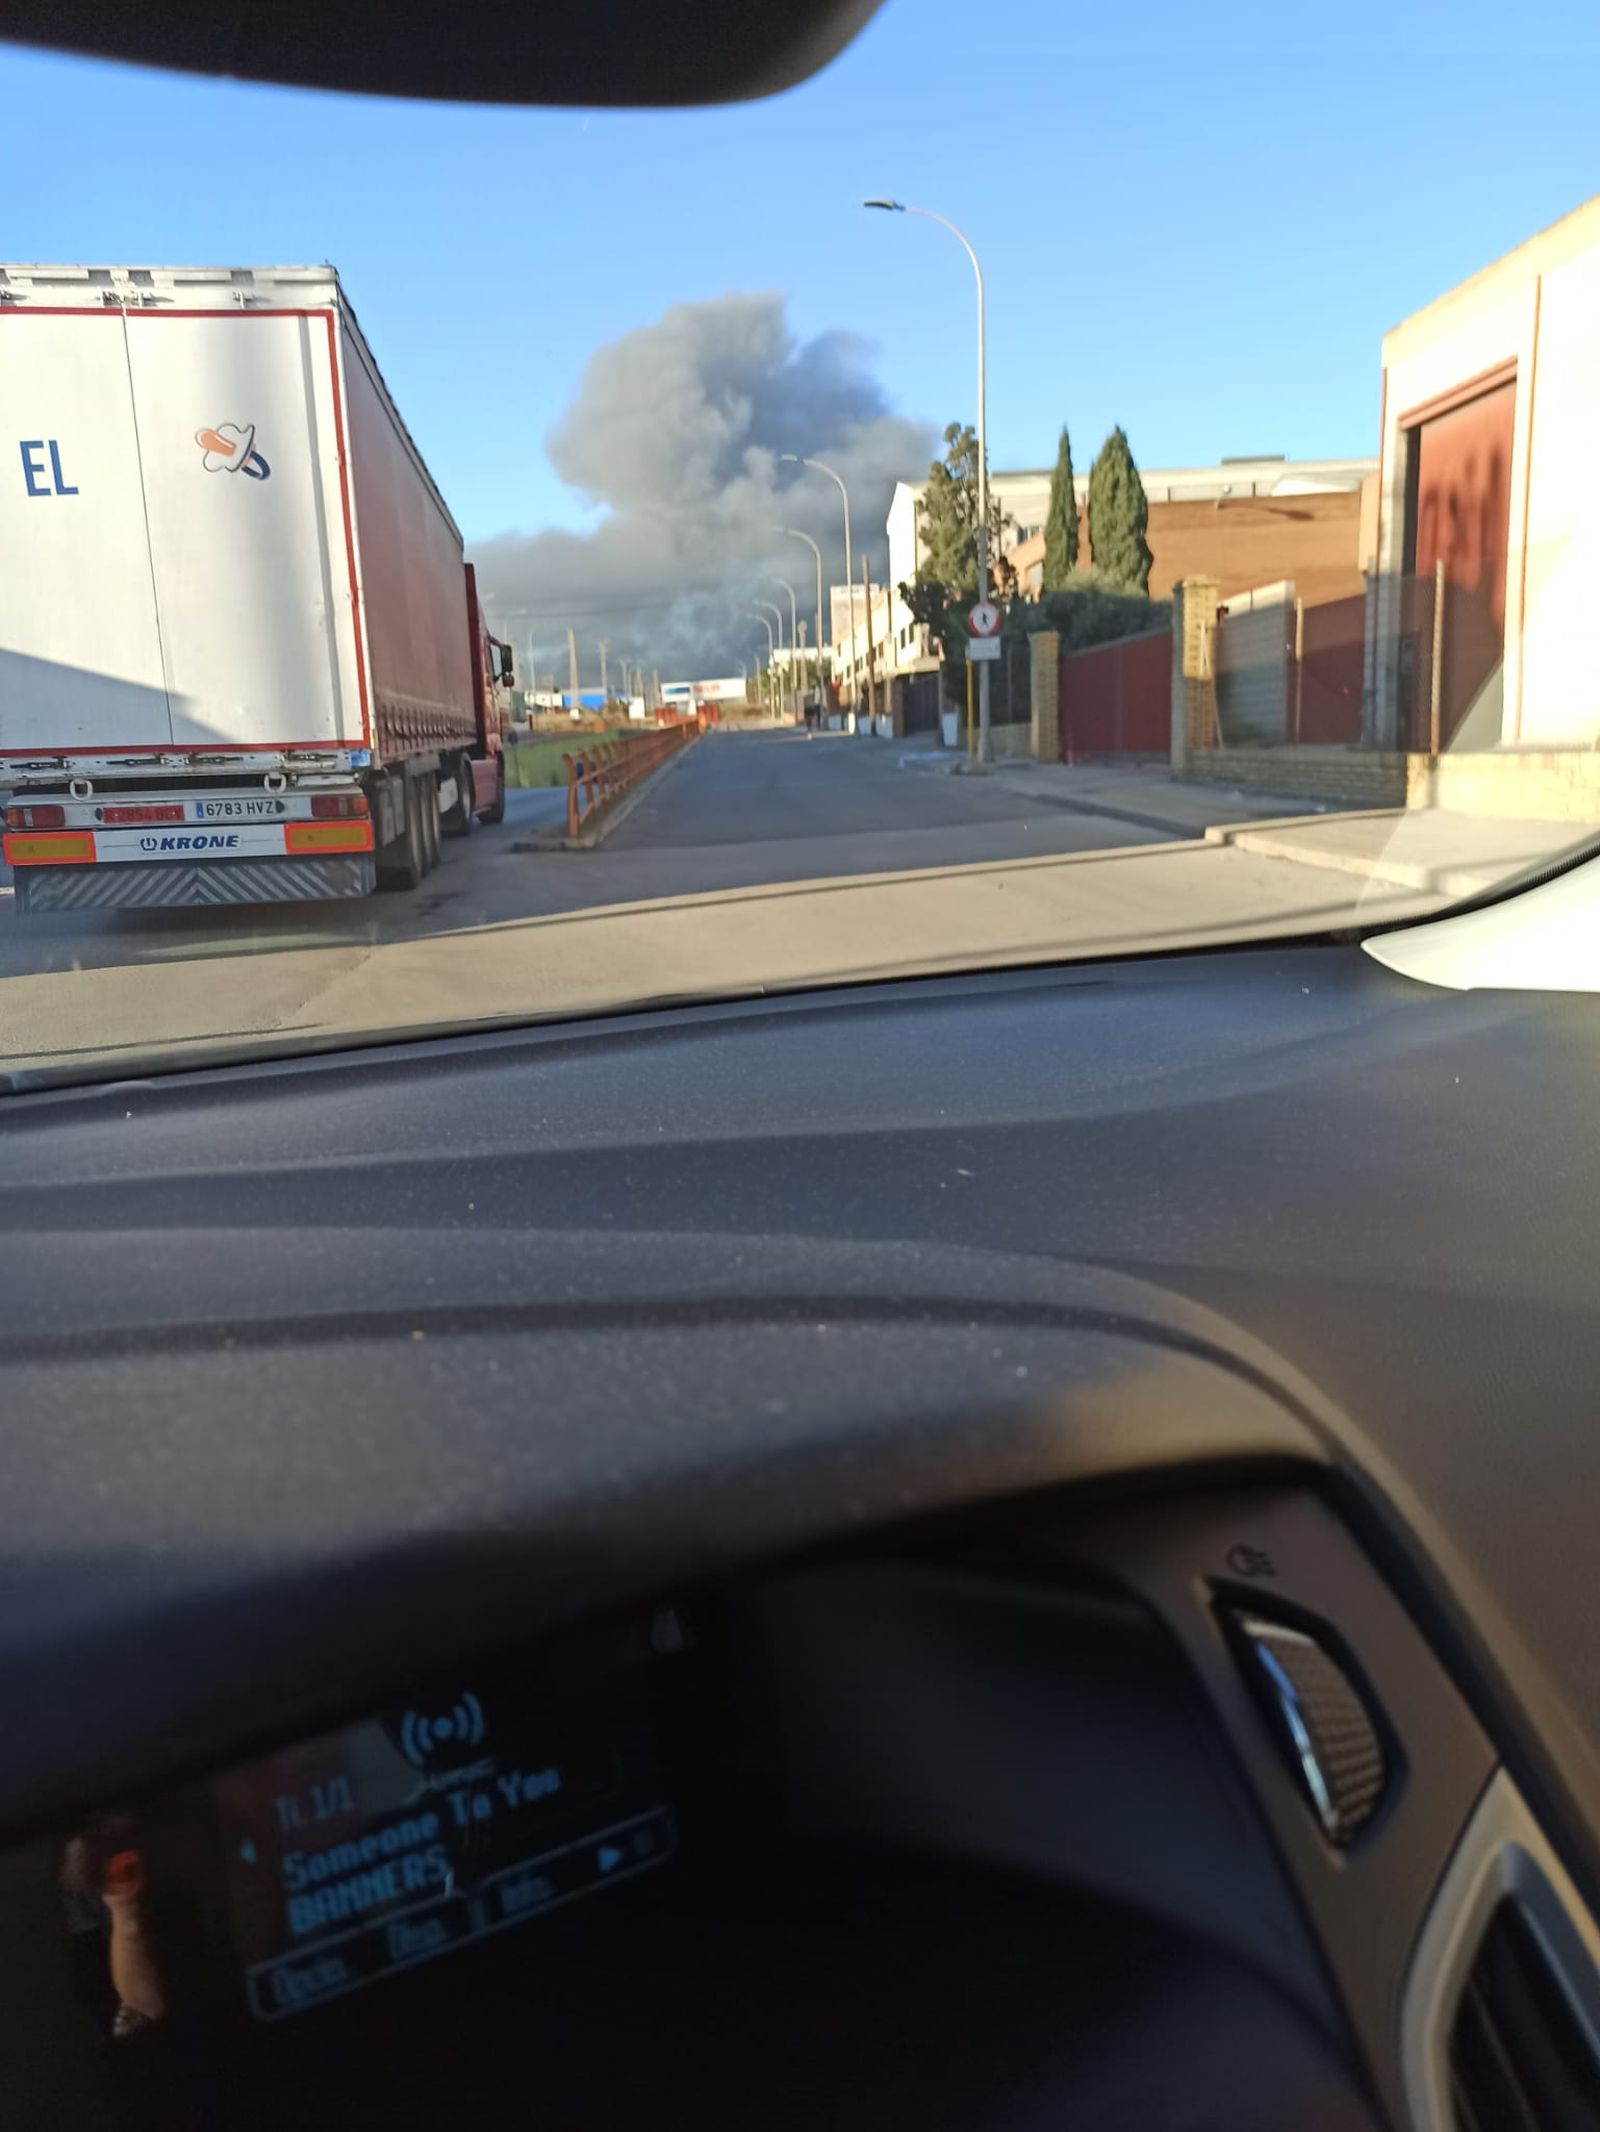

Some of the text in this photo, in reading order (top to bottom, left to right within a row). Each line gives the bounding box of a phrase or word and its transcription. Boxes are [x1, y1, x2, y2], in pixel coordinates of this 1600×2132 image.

[19, 440, 79, 497] EL
[206, 800, 274, 817] 6783 HVZ
[159, 835, 239, 851] KRONE
